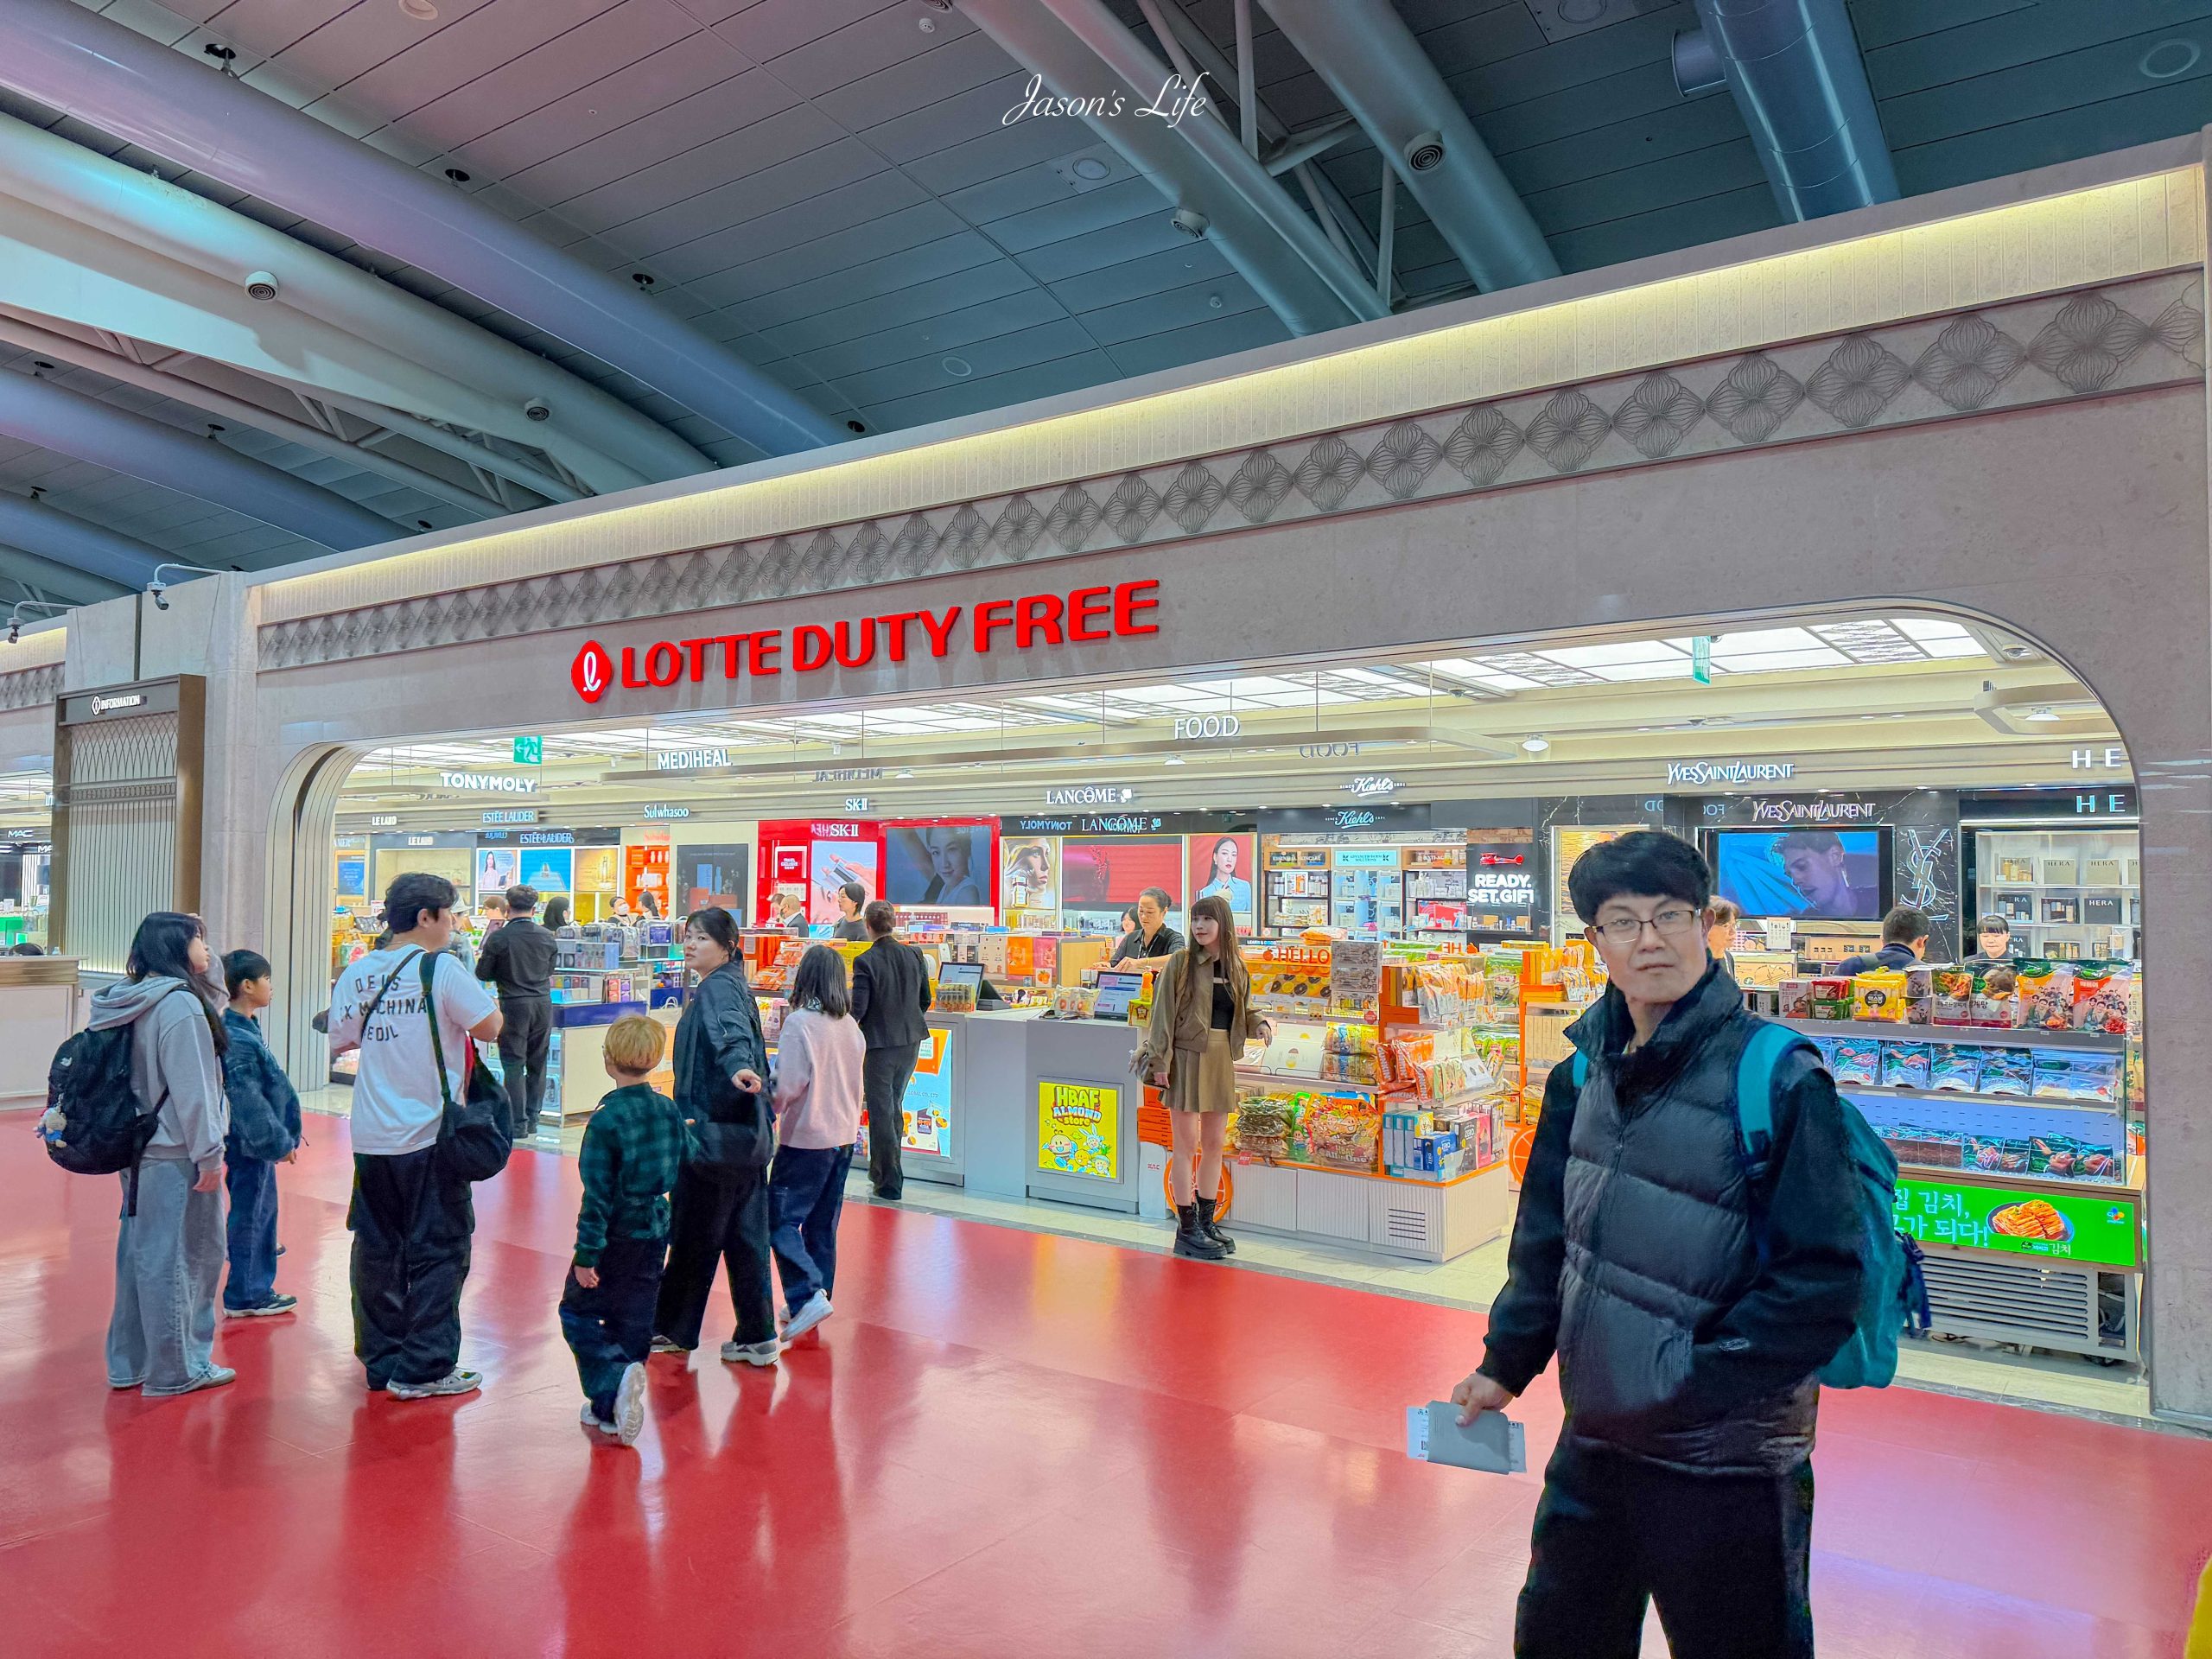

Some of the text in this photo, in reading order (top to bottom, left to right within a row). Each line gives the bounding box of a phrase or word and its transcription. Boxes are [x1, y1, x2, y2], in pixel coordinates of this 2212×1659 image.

[622, 580, 1159, 688] LOTTE DUTY FREE
[100, 695, 140, 710] INFORMATION
[1173, 715, 1240, 740] FOOD
[657, 749, 732, 770] MEDIHEAL
[439, 772, 537, 792] TONYMOLY
[1351, 777, 1394, 795] Kiehl's
[1046, 785, 1117, 805] LANCÔME
[643, 804, 690, 818] Sulwhasoo
[845, 798, 868, 811] SK-II
[504, 810, 534, 823] LAUDER
[1334, 810, 1375, 827] Kiehl's
[830, 823, 859, 836] SK-II
[1474, 874, 1532, 888] READY.
[1277, 947, 1331, 964] HELLO
[1054, 1085, 1101, 1109] HBAF
[1052, 1106, 1102, 1122] ALMOND
[1064, 1116, 1091, 1127] store
[1918, 1191, 1970, 1219] 김치,
[1934, 1218, 1989, 1247] 되다!
[2049, 1243, 2071, 1256] 김치
